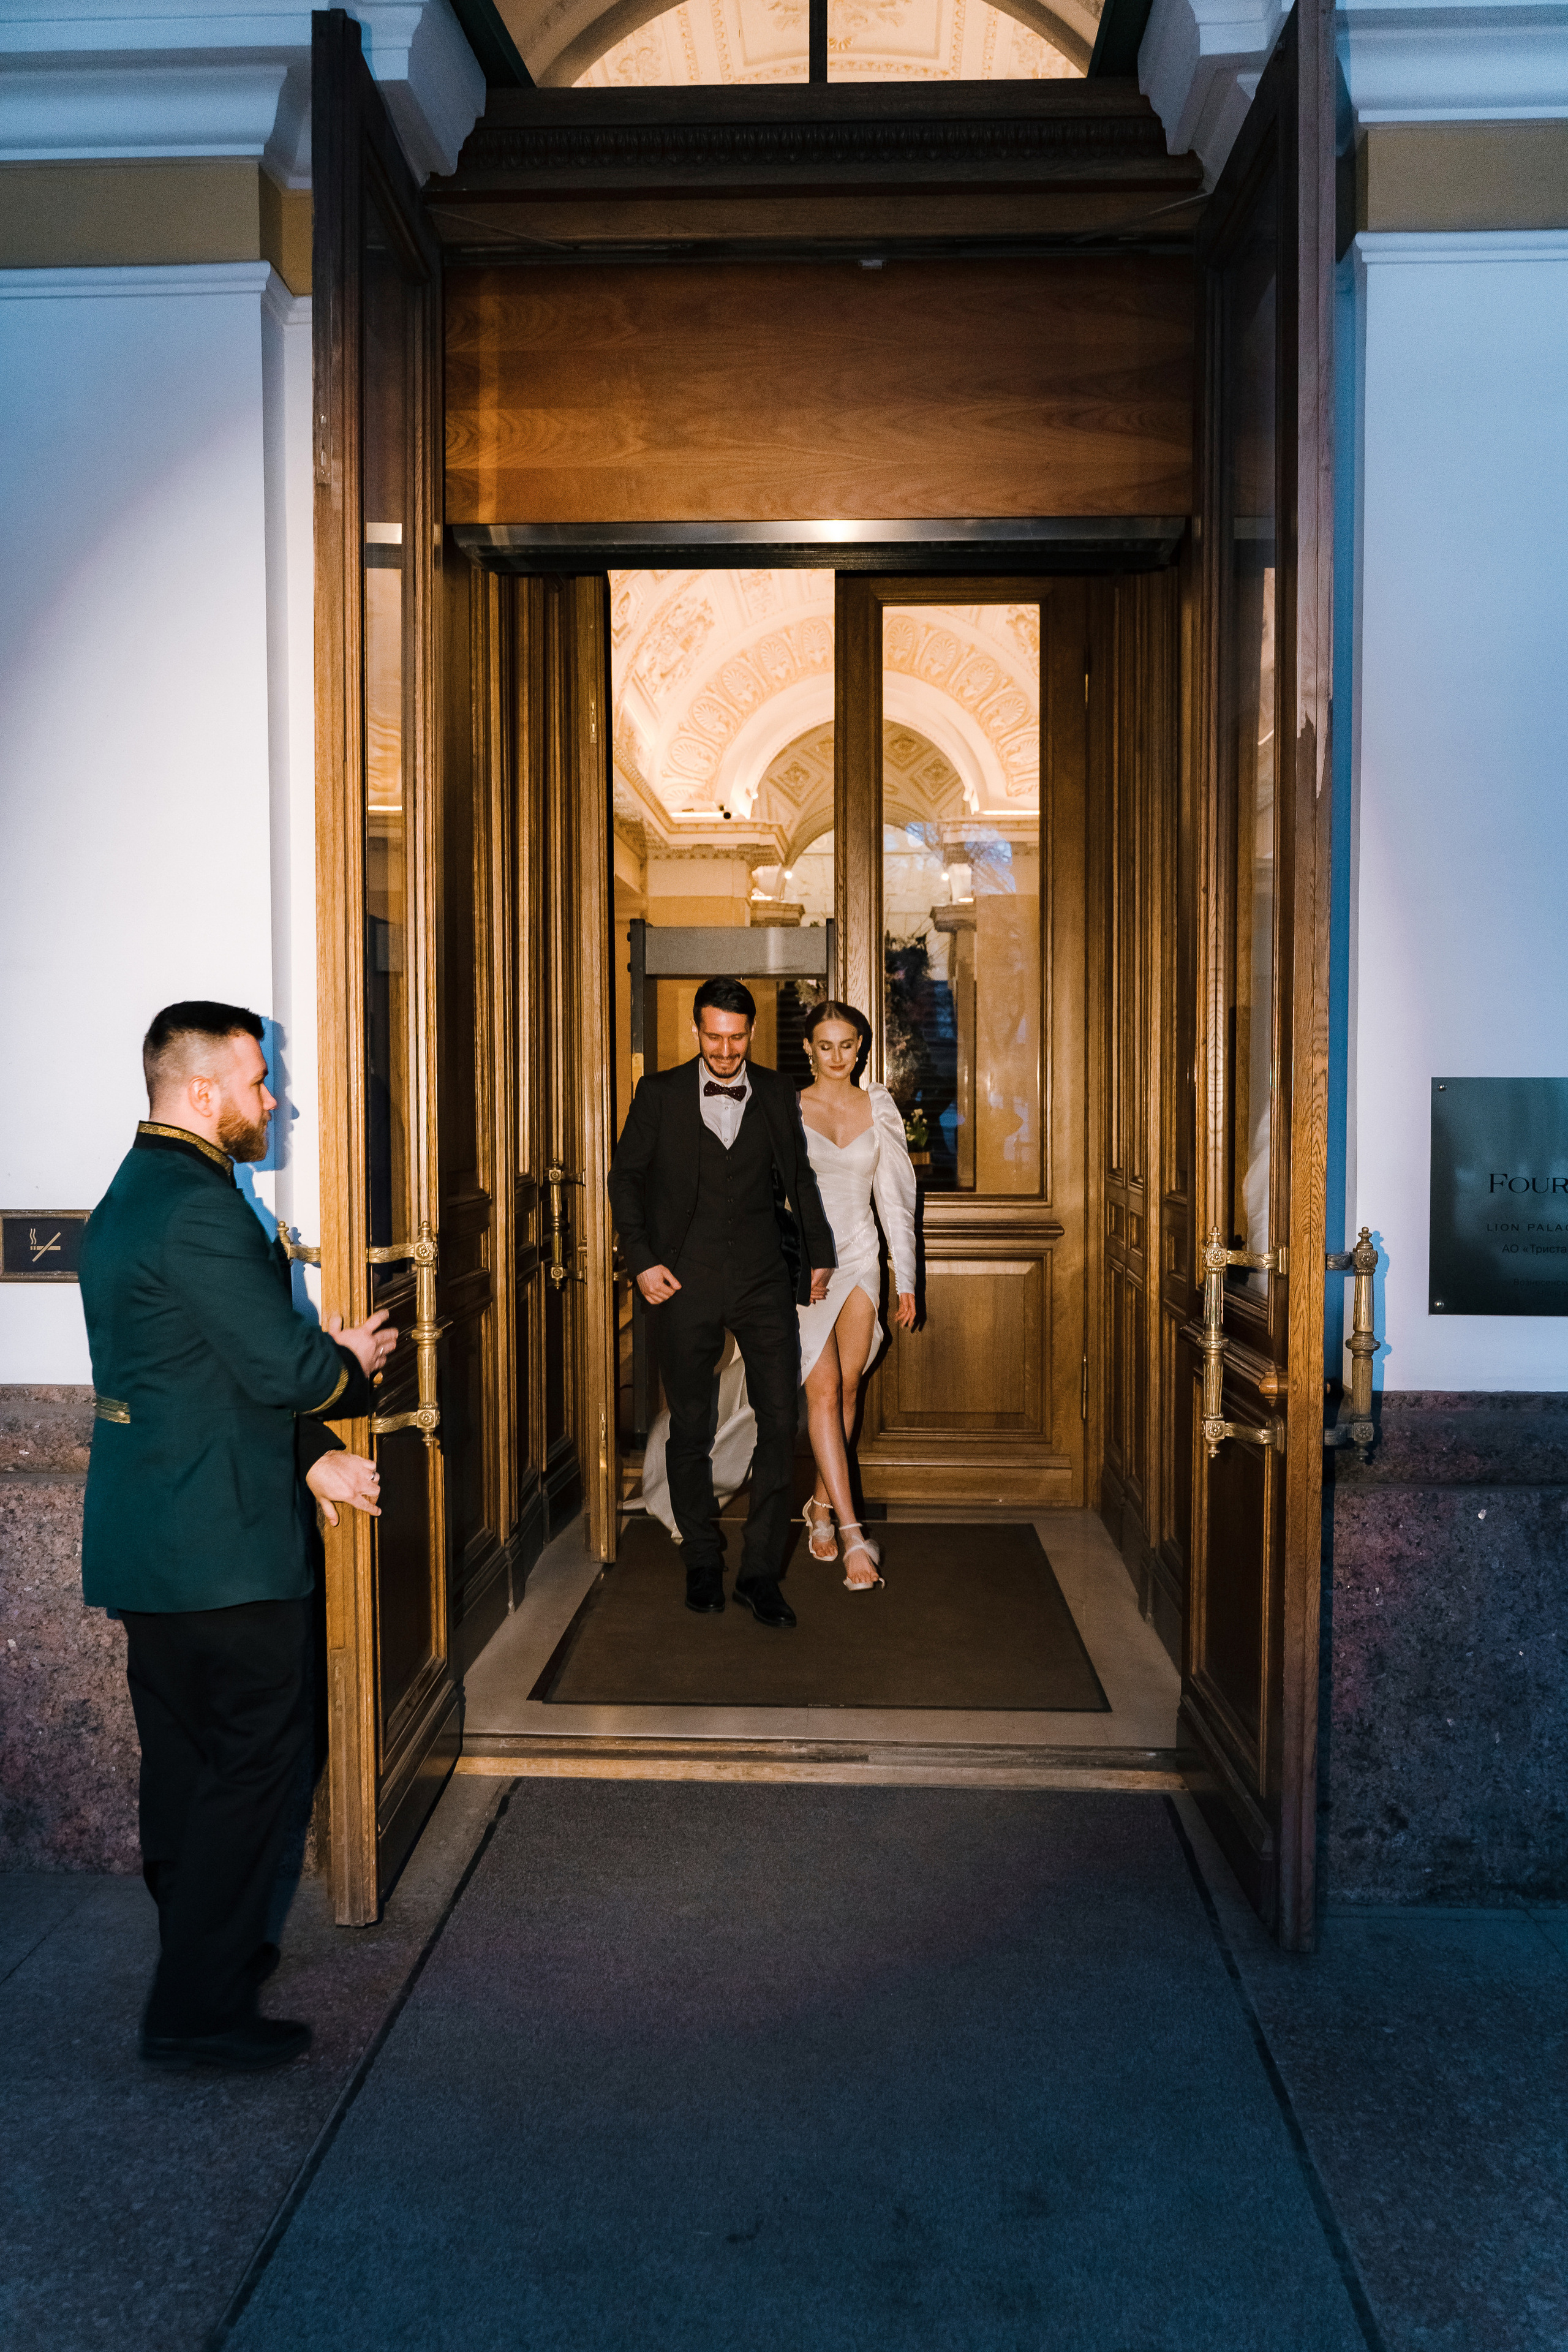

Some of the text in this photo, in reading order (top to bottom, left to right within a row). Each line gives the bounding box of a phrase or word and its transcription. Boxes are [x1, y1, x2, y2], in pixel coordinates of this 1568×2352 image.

[1488, 1173, 1568, 1194] FOUR
[1487, 1223, 1520, 1232] LION
[1502, 1243, 1519, 1253] АО
